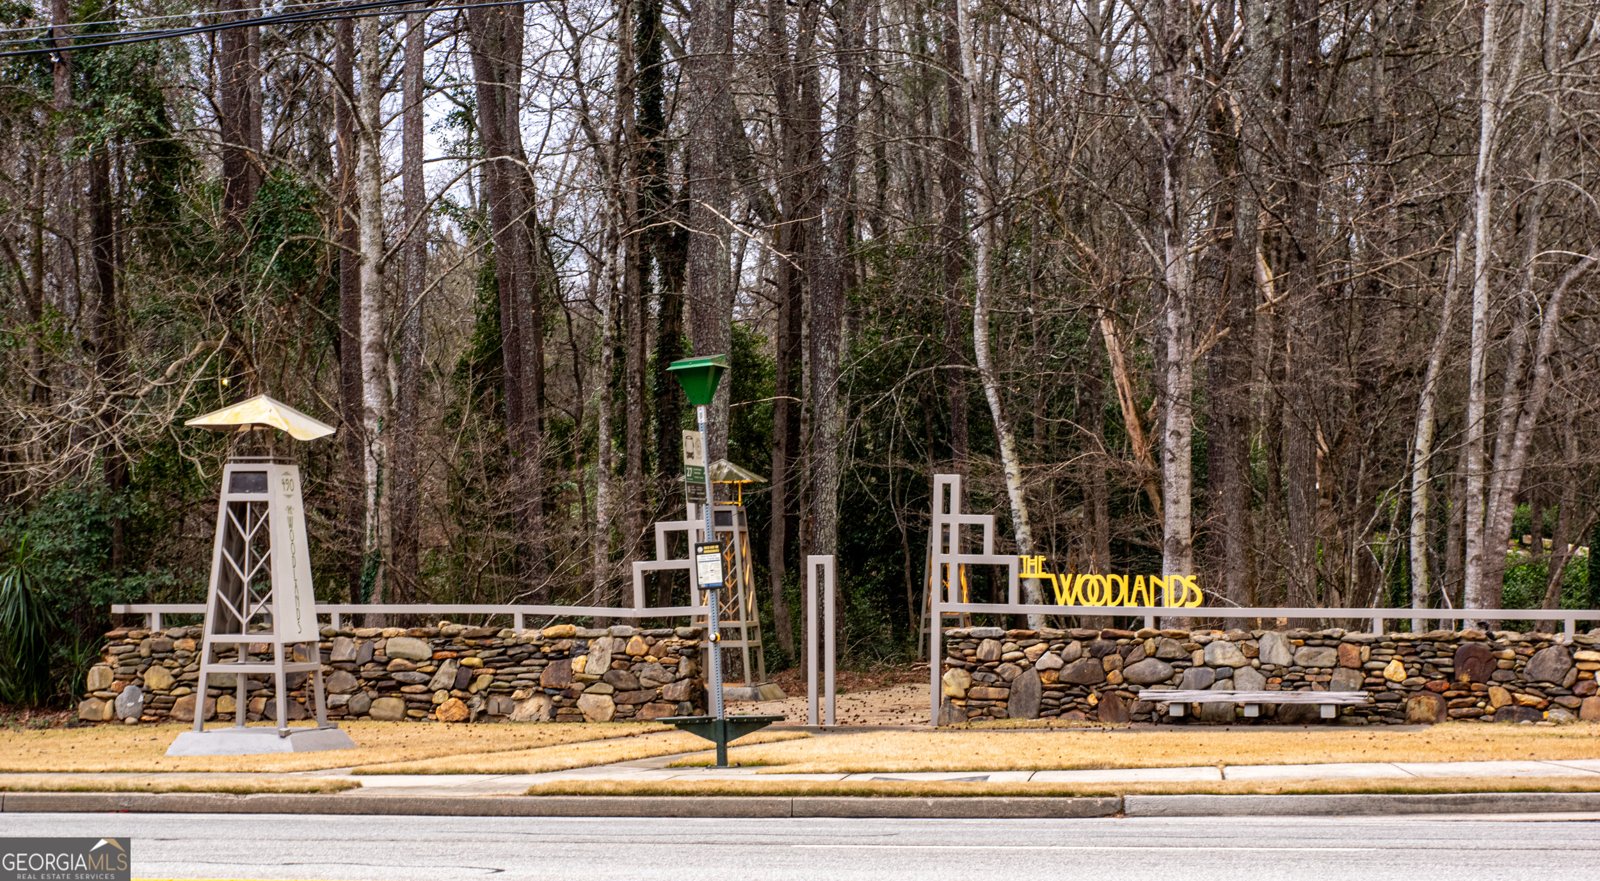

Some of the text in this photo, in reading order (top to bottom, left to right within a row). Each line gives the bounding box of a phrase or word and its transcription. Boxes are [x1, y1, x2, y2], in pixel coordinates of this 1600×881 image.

[286, 515, 302, 634] WOODLANDS
[1020, 555, 1047, 575] THE
[1051, 573, 1203, 608] WOODLANDS
